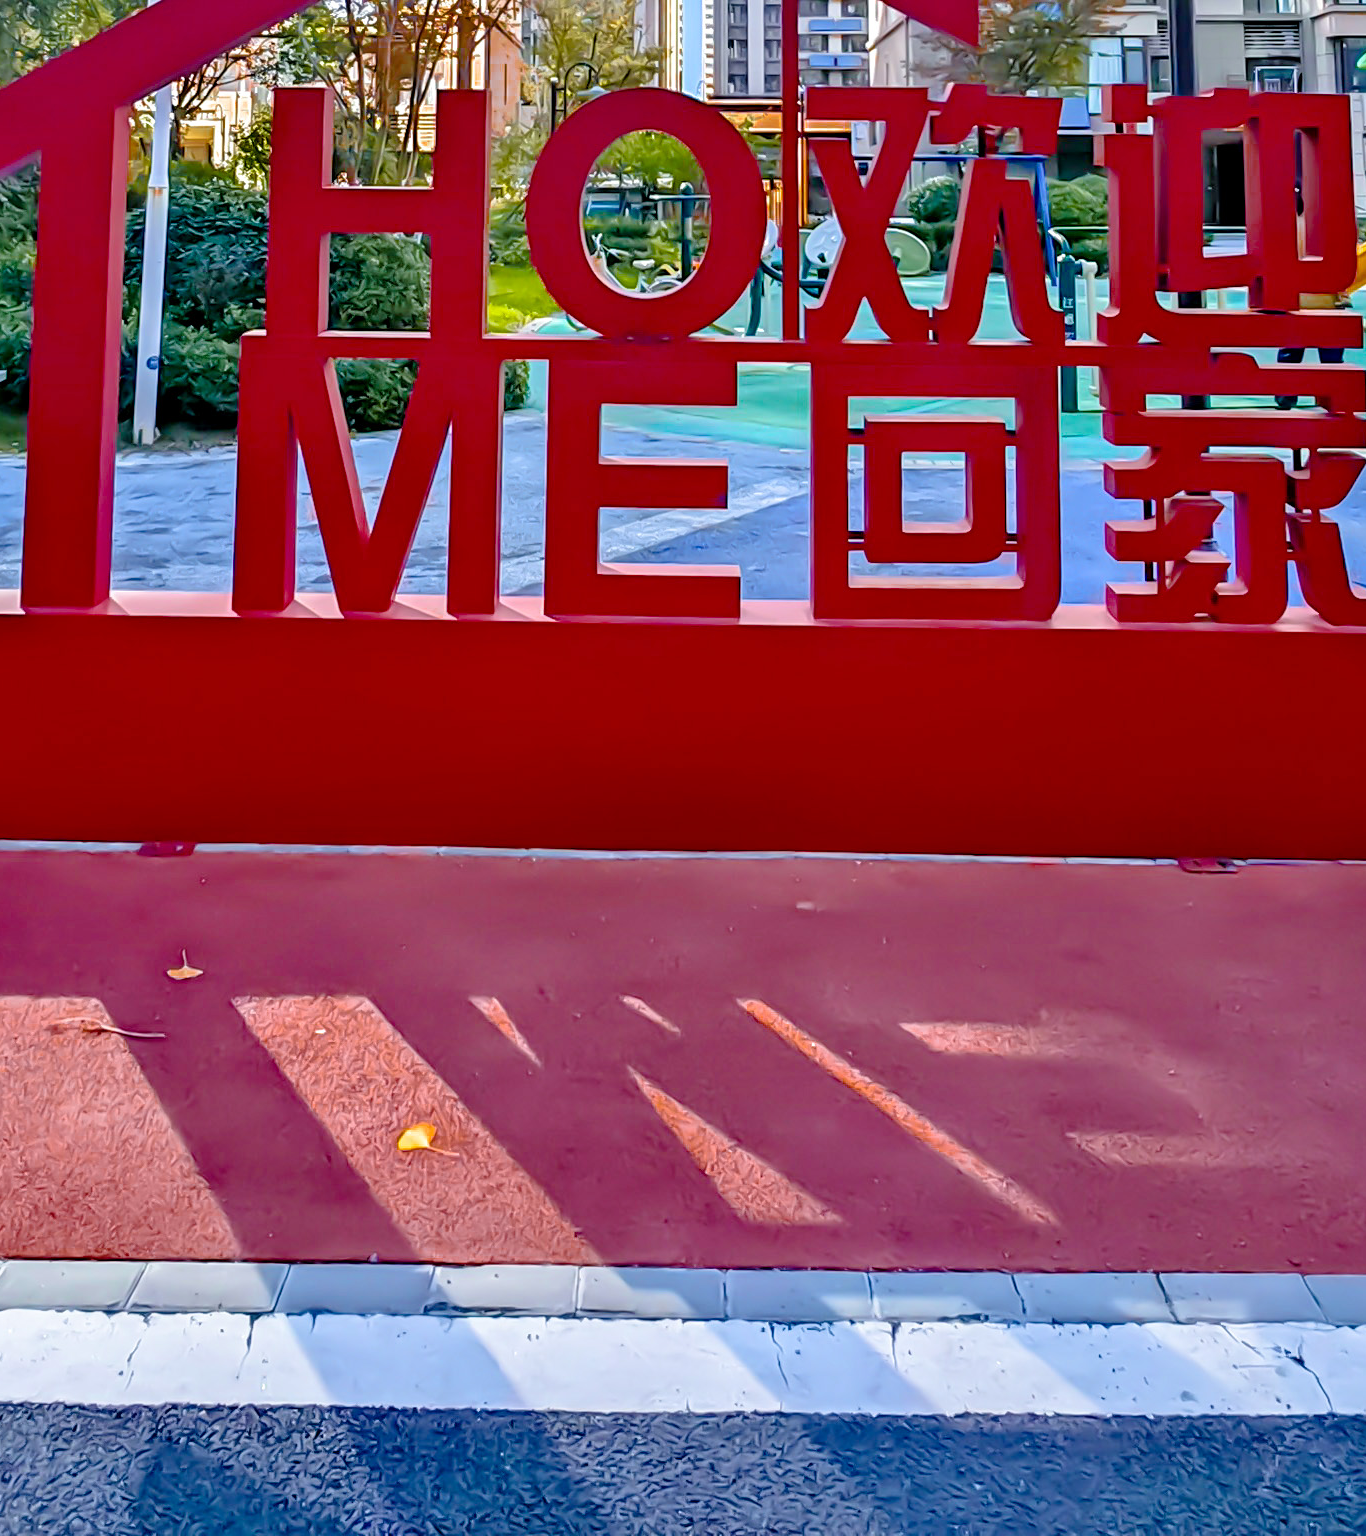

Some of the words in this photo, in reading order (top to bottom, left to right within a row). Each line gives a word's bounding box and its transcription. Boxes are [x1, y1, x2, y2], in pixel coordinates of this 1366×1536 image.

[266, 86, 767, 340] HO
[804, 82, 1364, 348] 欢迎
[232, 332, 742, 620] ME
